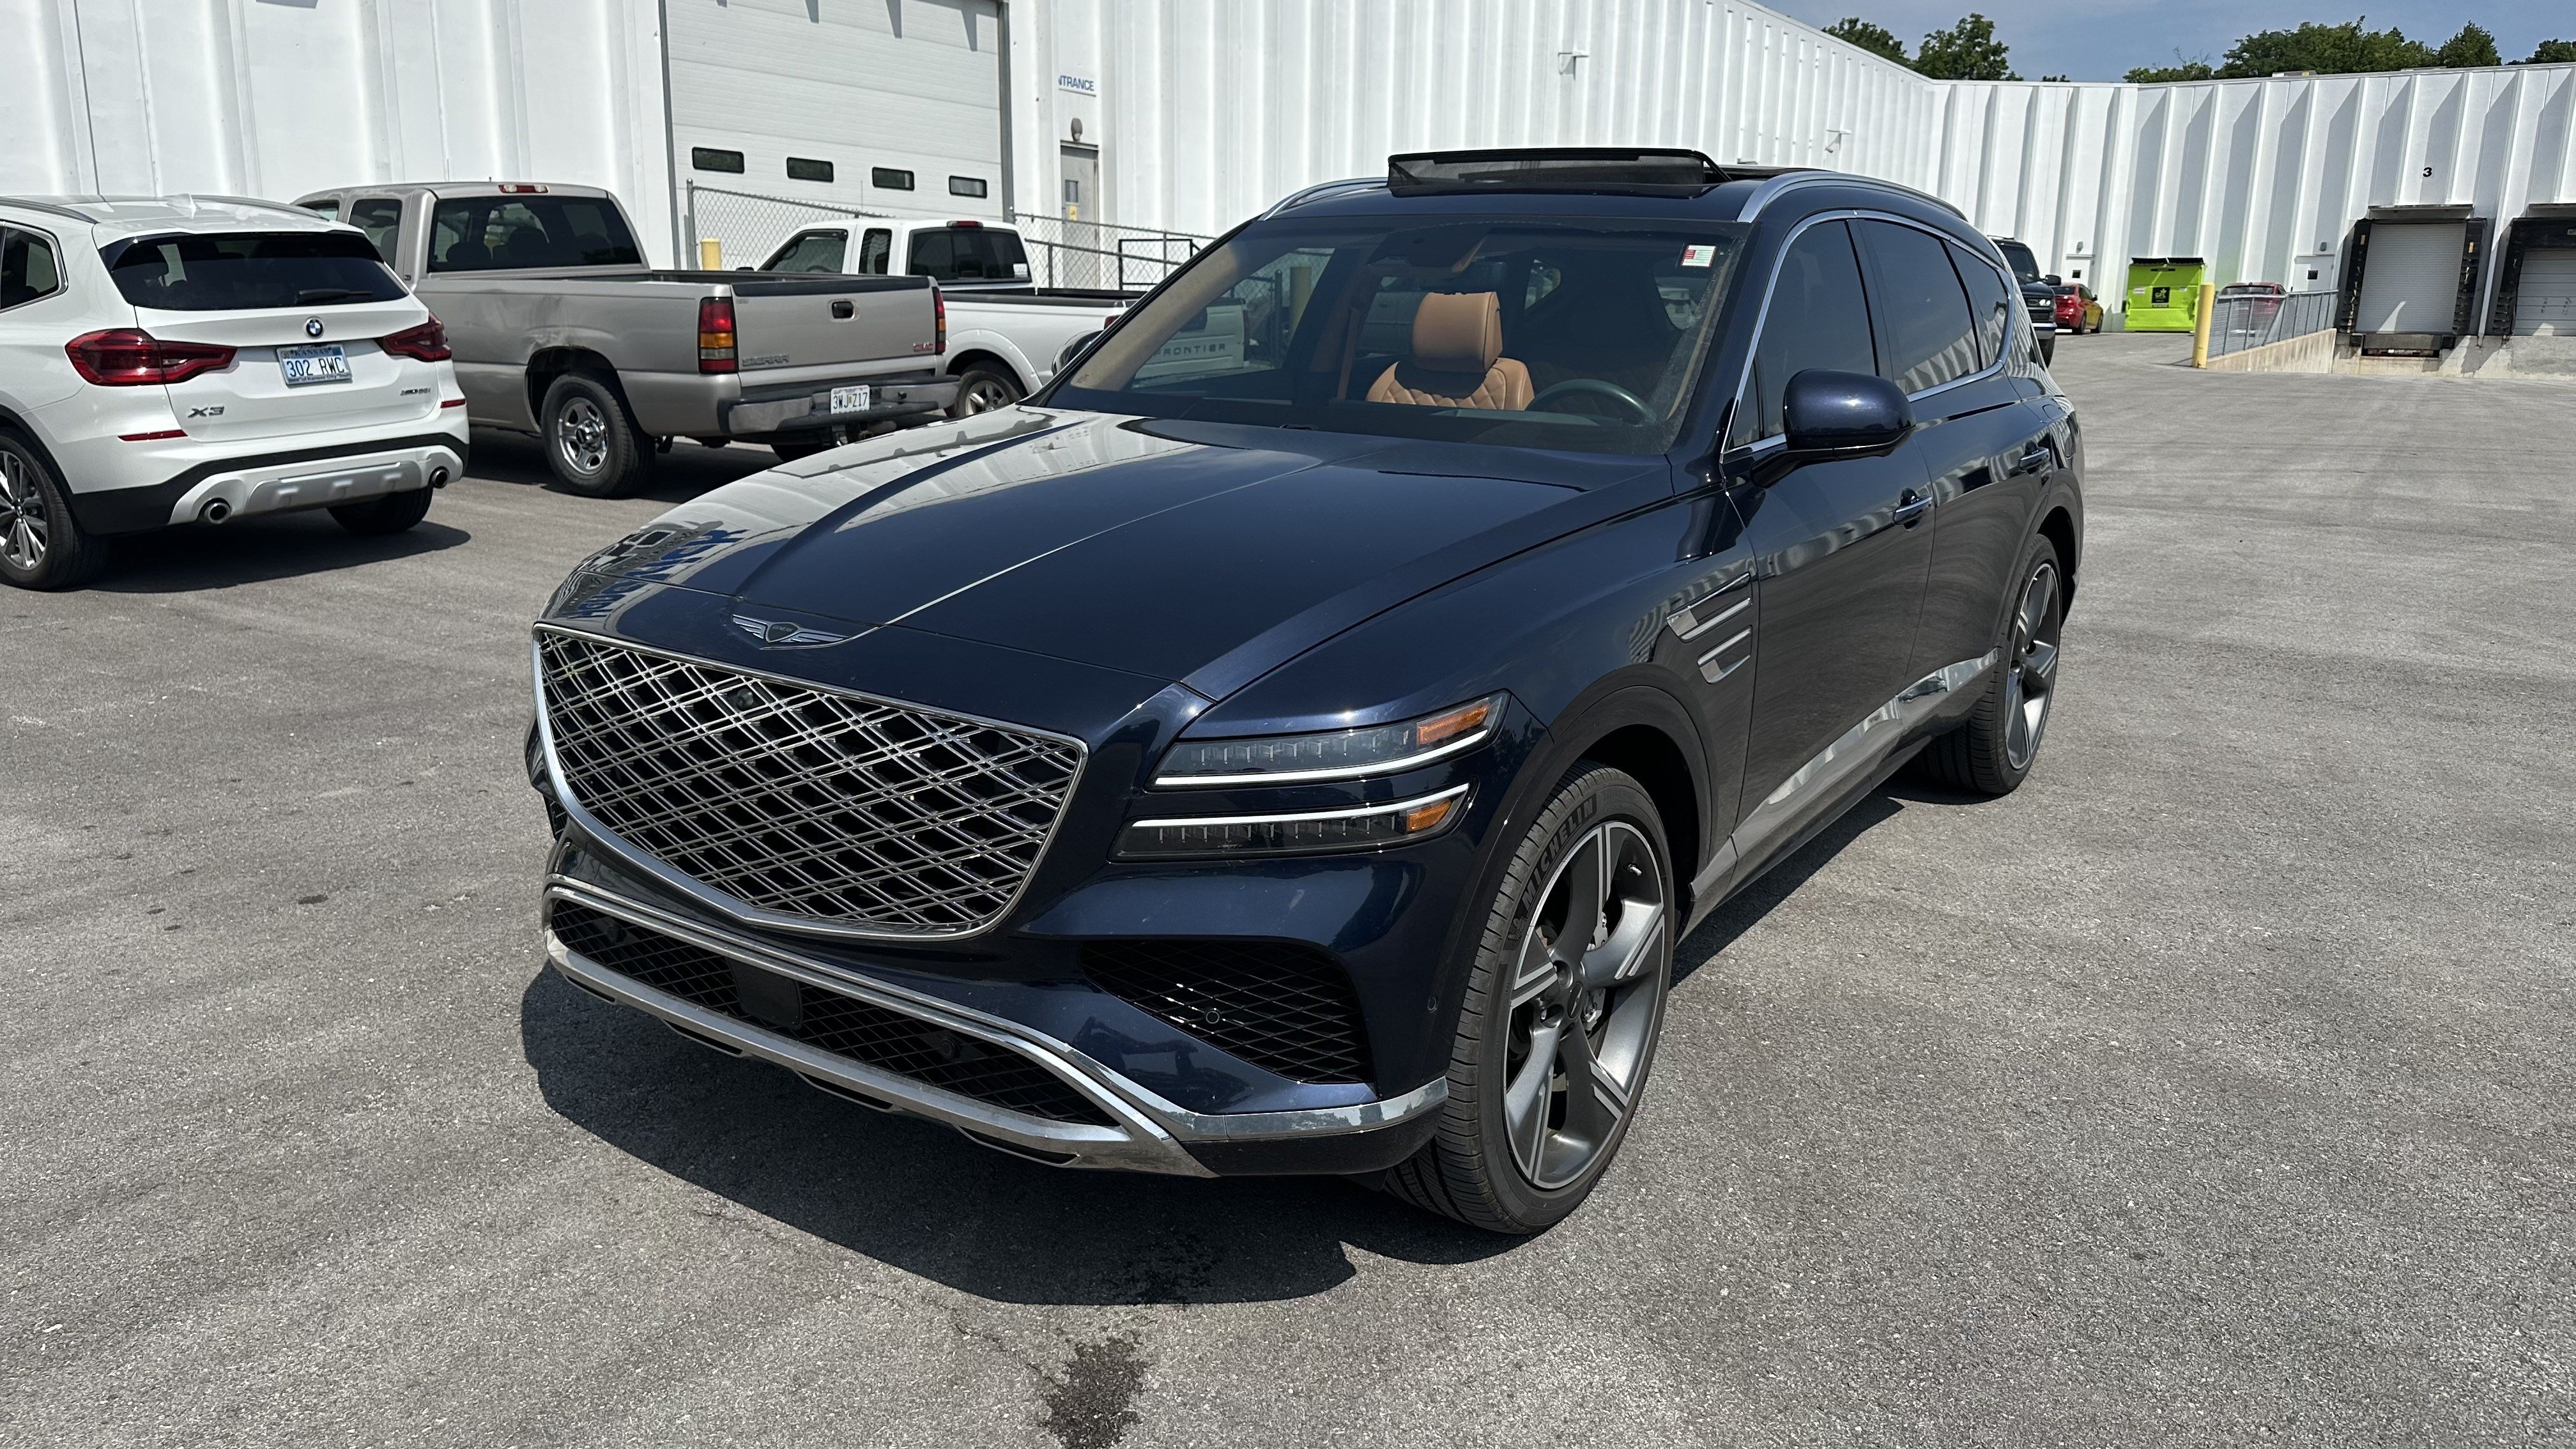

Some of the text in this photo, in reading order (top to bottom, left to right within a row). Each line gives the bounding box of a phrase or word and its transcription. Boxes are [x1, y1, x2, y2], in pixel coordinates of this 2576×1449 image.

[2423, 167, 2432, 178] 3
[287, 357, 344, 377] 302 RWC
[188, 406, 224, 418] X3
[1522, 798, 1593, 912] MICHELIN
